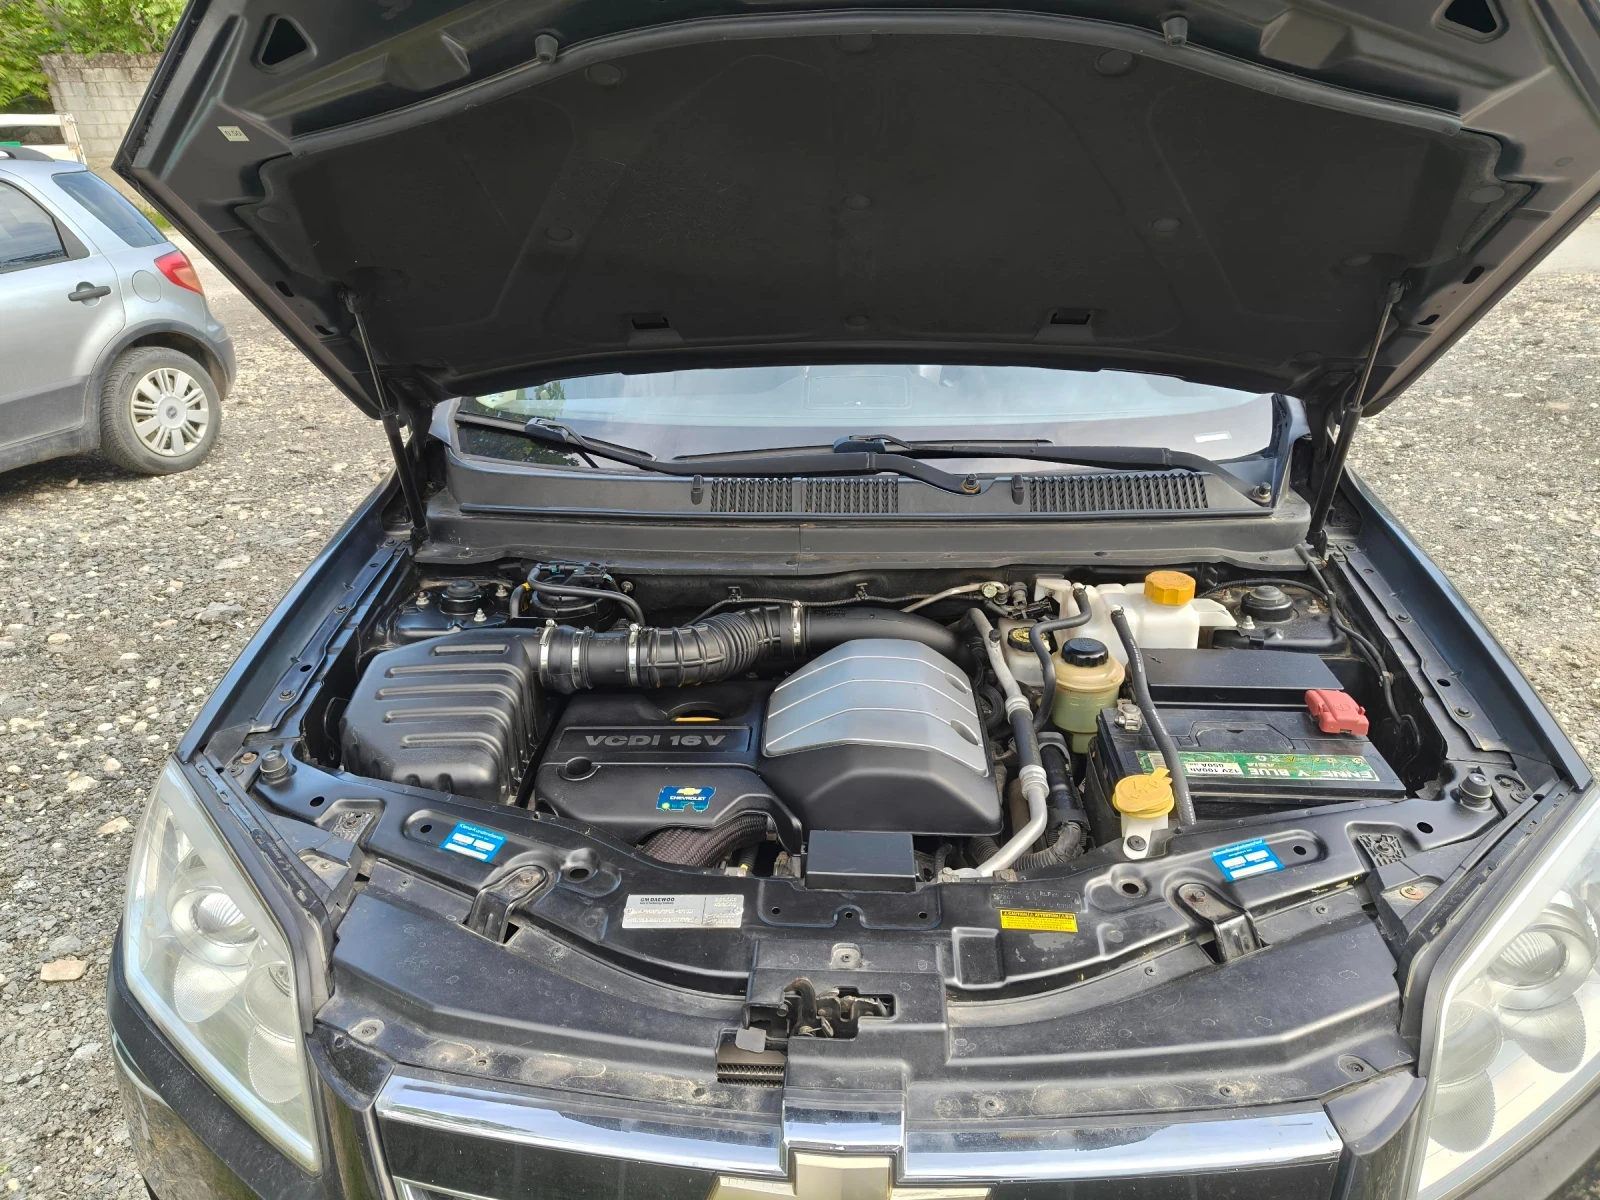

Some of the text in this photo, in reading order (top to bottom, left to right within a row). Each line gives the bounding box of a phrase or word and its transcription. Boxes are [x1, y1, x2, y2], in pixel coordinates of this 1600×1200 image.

[585, 735, 726, 746] VCDI 16V
[1248, 768, 1291, 776] BLUE
